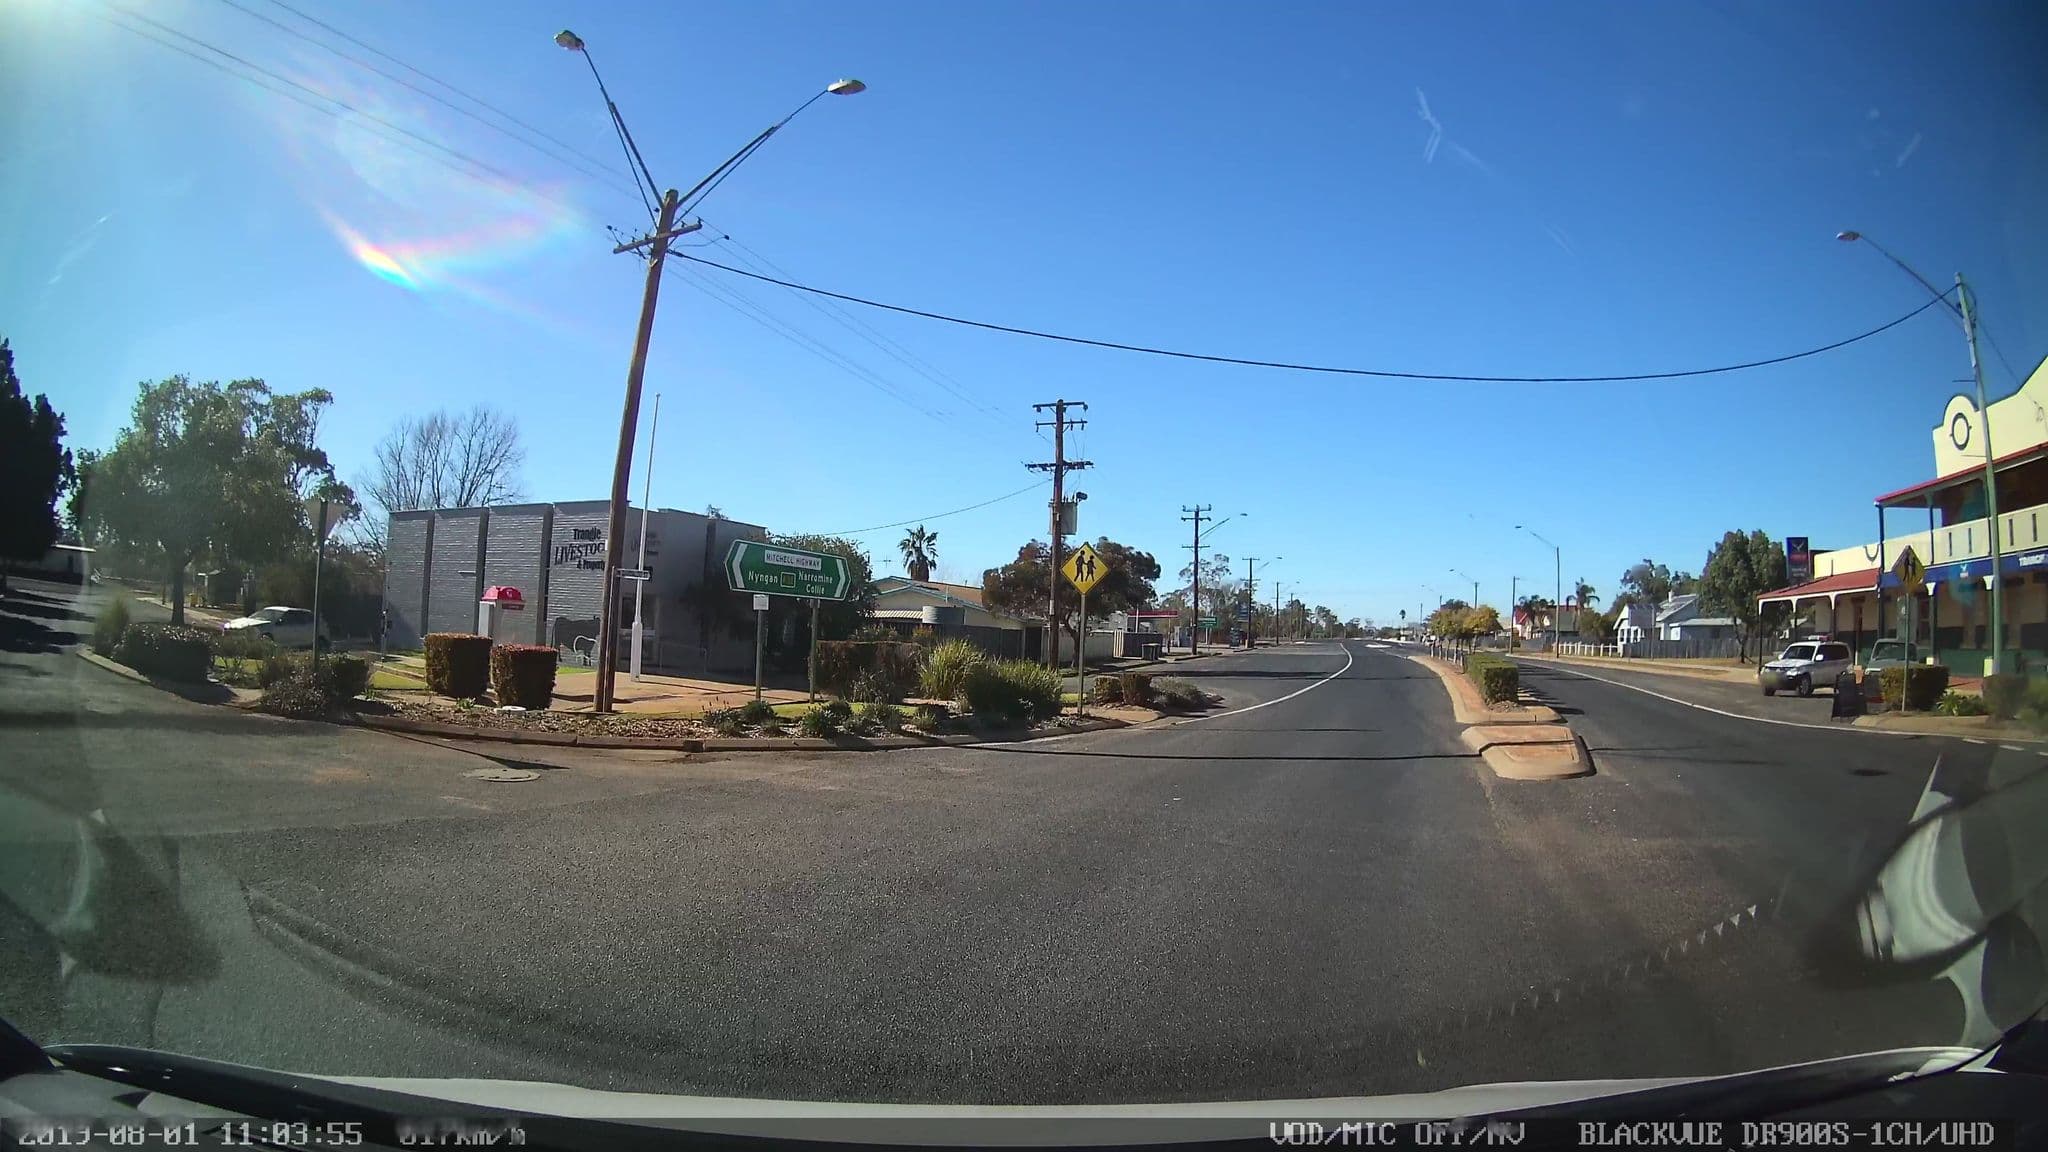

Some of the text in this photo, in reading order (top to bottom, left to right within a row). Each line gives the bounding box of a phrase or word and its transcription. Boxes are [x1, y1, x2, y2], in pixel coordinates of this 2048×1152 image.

[554, 543, 606, 565] LIVESTOC
[766, 553, 820, 568] MITCHELL HIGHWAY
[748, 571, 778, 584] Nyngan
[798, 571, 833, 584] Narromine
